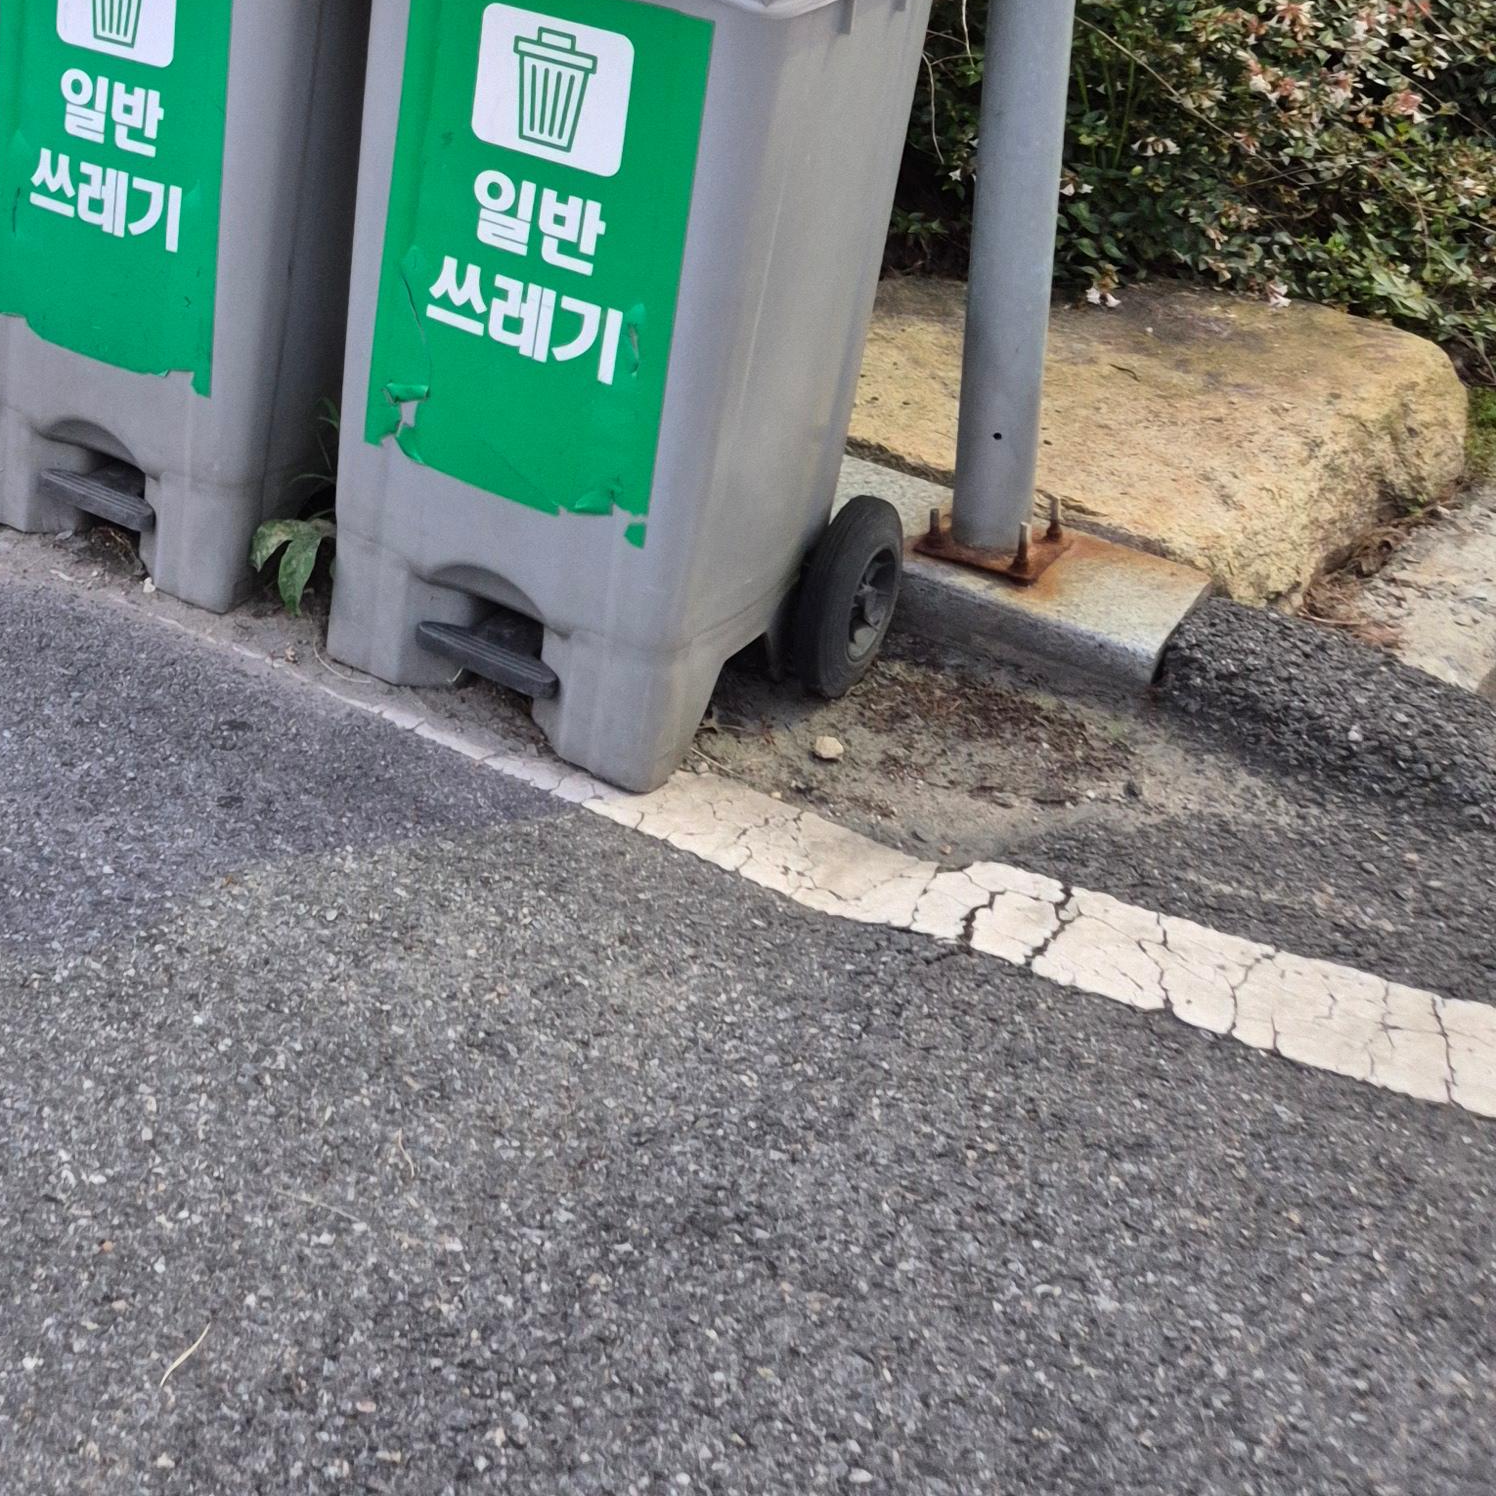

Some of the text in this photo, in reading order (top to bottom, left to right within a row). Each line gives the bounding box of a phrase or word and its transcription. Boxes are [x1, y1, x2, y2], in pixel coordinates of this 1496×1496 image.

[60, 68, 164, 158] 일반
[29, 147, 182, 253] 쓰레기
[474, 170, 606, 276] 일반
[426, 255, 623, 385] 쓰레기
